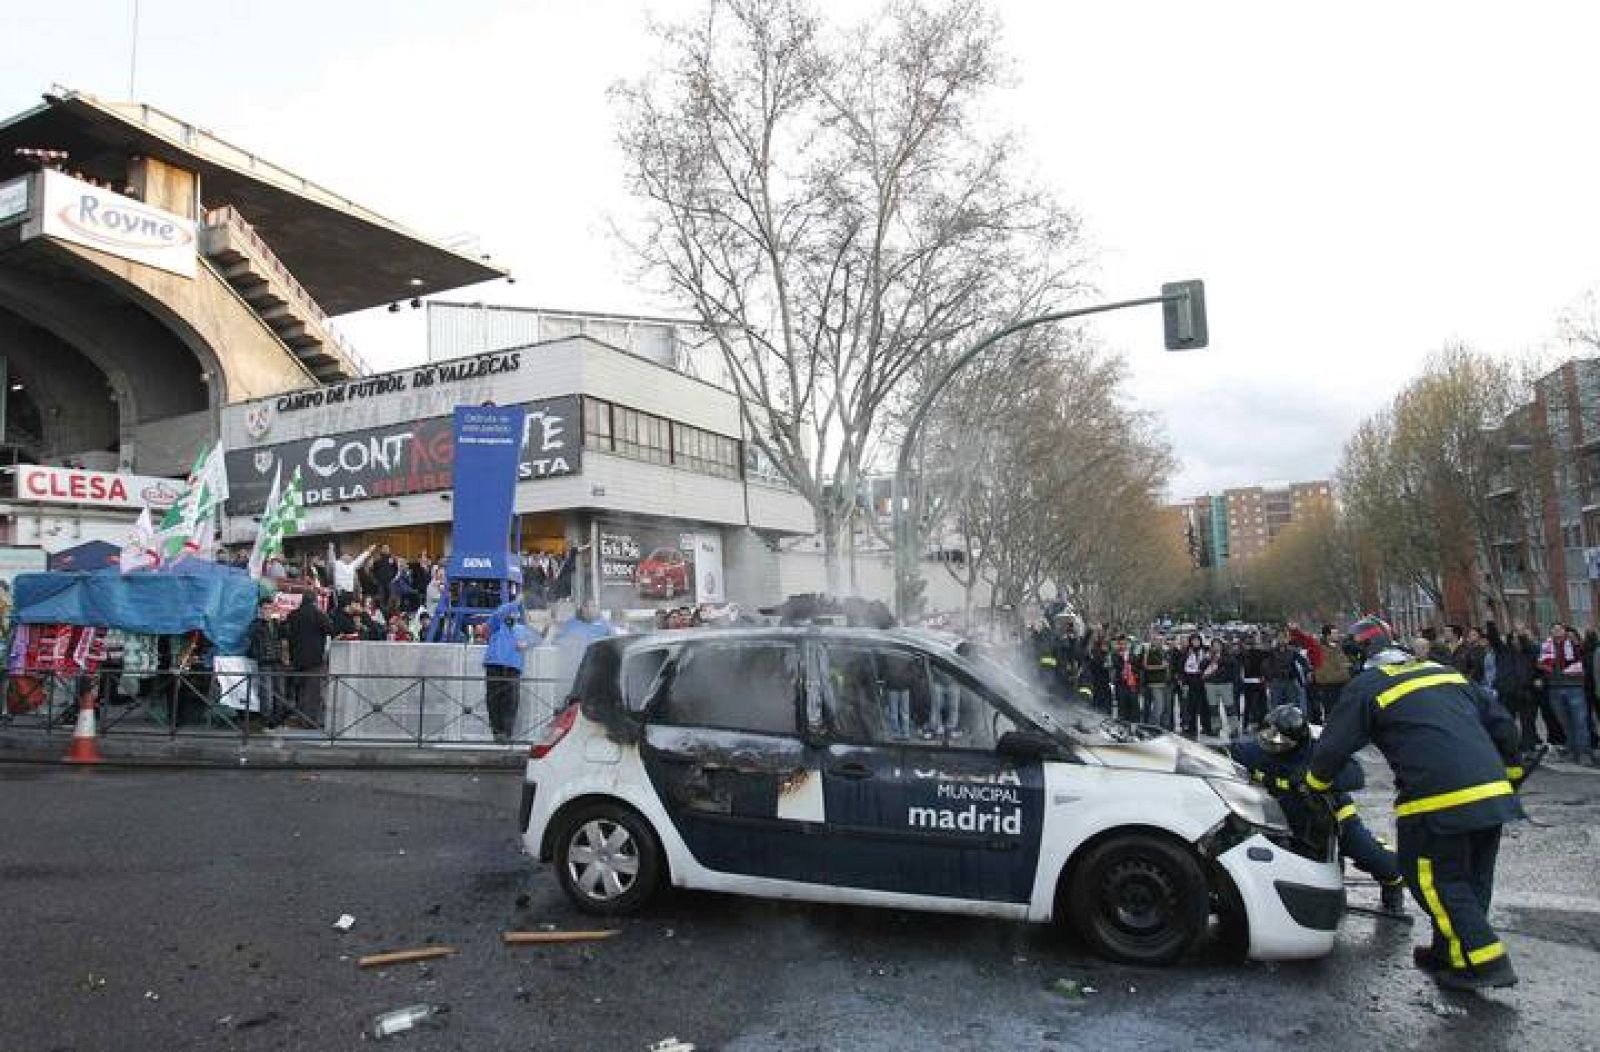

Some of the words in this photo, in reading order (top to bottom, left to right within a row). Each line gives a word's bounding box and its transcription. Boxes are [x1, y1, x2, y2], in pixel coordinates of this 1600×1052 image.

[79, 195, 175, 241] Royne
[277, 388, 322, 411] CAMPO
[326, 383, 345, 404] DE
[413, 366, 435, 388] DE
[439, 353, 521, 381] VALLECAS
[26, 471, 128, 501] CLESA
[306, 486, 332, 504] DE
[339, 484, 367, 499] LA
[938, 784, 1022, 804] MUNICIPAL
[908, 805, 1021, 835] madrid
